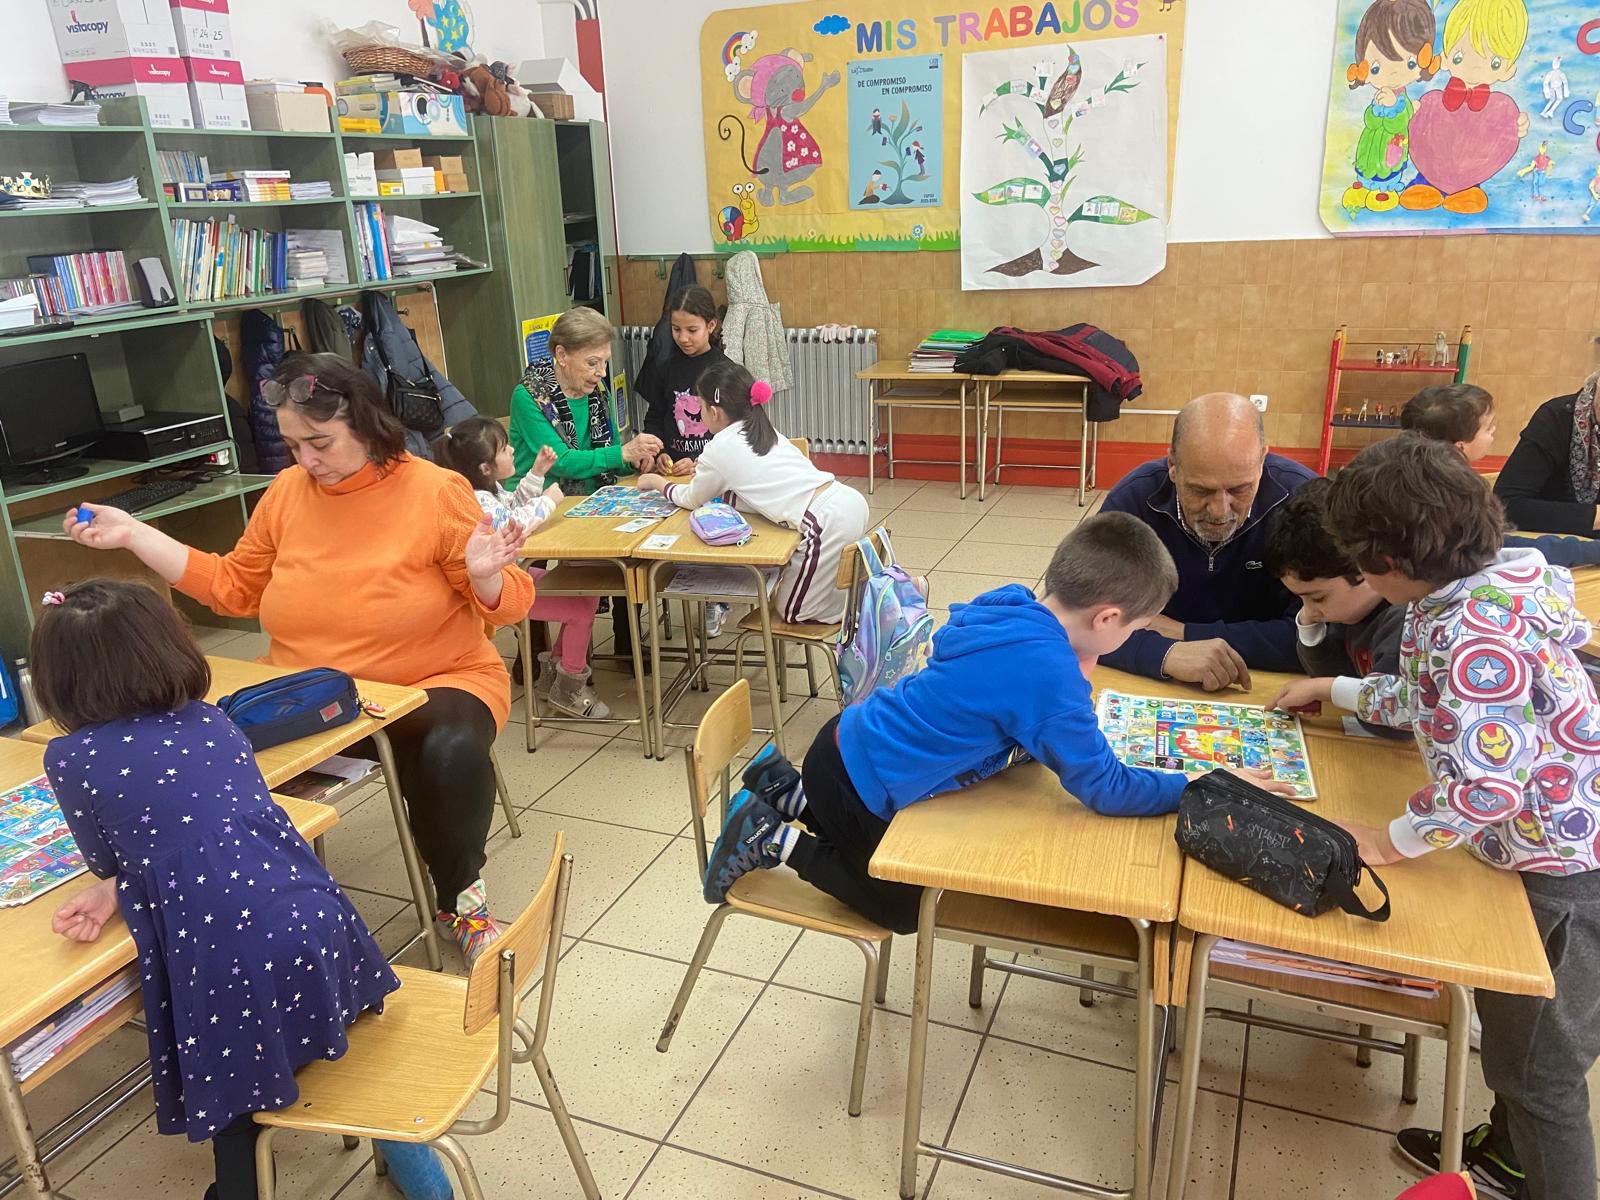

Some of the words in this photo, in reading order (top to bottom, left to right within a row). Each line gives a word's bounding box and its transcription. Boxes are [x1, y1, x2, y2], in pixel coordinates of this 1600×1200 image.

[66, 20, 109, 34] vistacopy
[856, 19, 917, 54] MIS
[933, 0, 1140, 47] TRABAJOS
[857, 80, 865, 88] DE
[866, 76, 907, 88] COMPROMISO
[881, 87, 890, 96] EN
[891, 84, 933, 95] COMPROMISO
